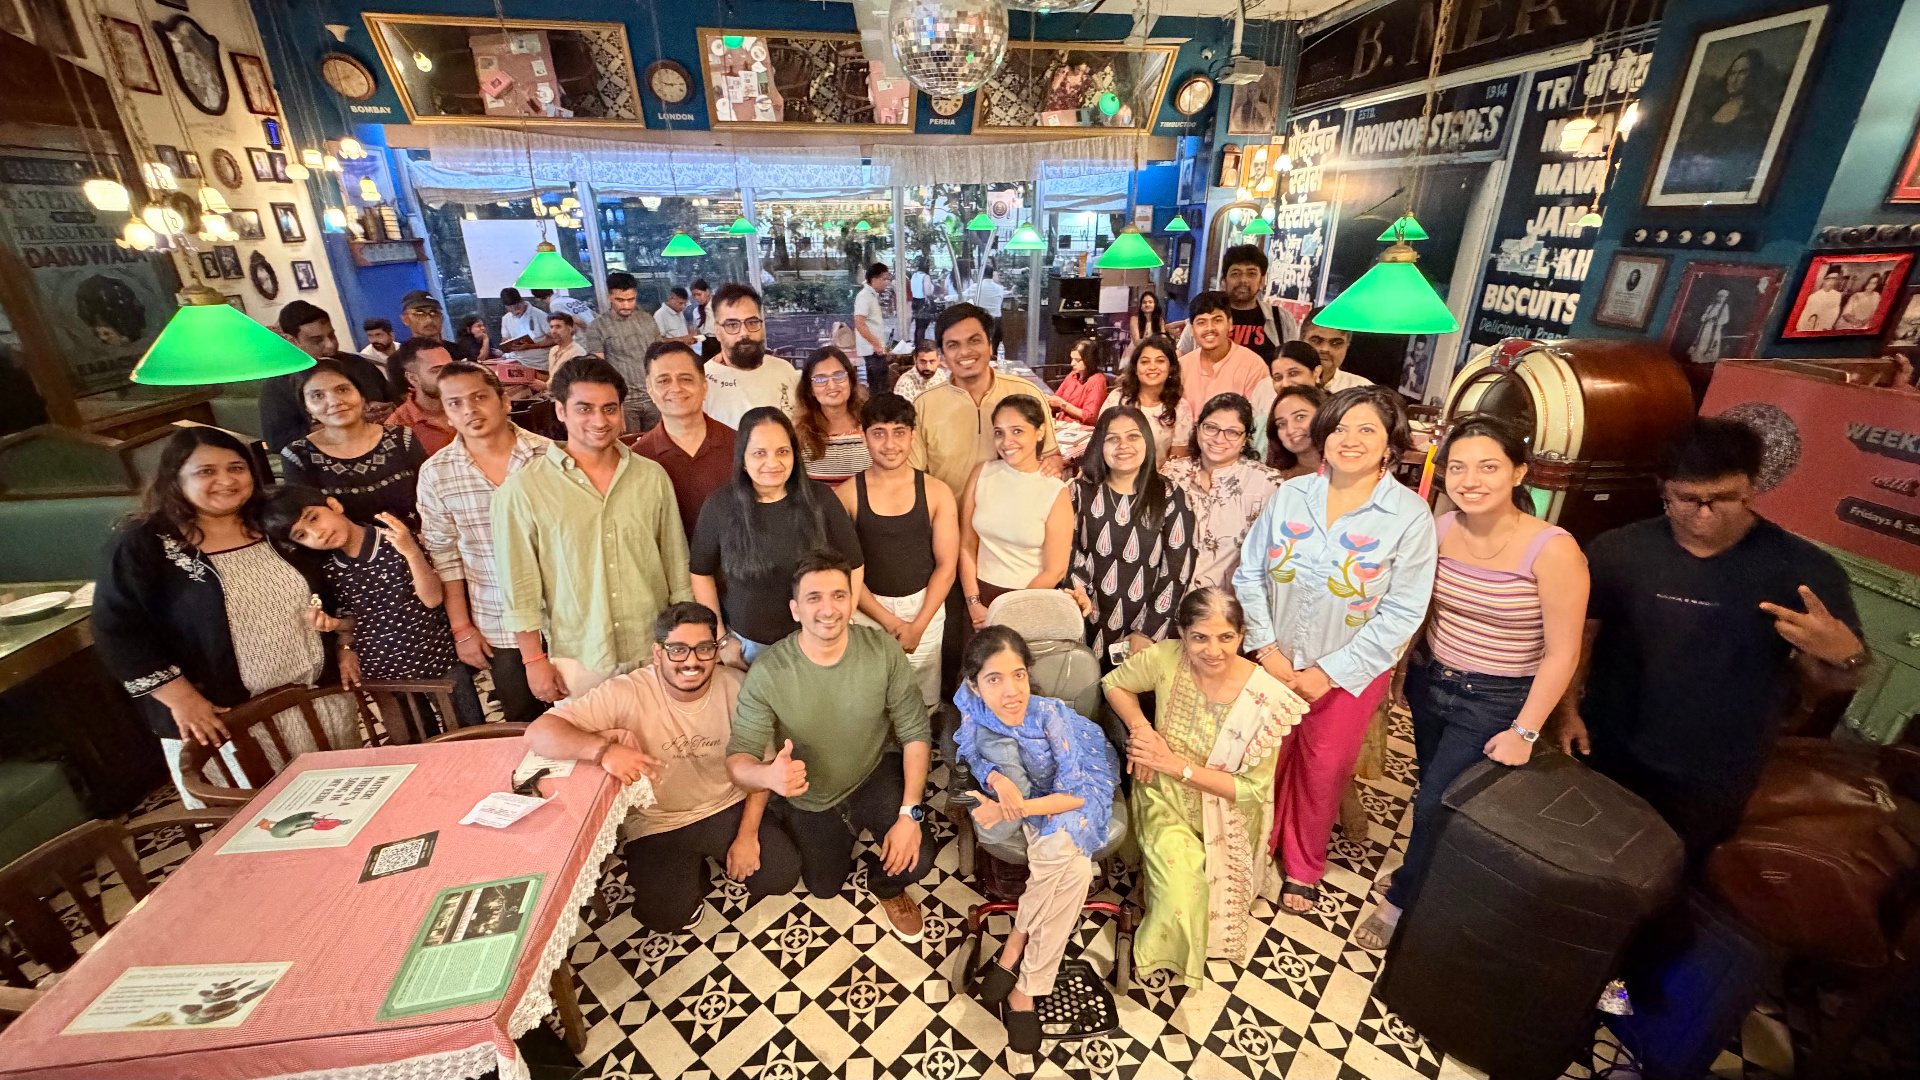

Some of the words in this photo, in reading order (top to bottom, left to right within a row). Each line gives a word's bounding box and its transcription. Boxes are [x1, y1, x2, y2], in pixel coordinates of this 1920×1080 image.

[1485, 83, 1509, 100] 1914
[350, 105, 392, 114] BOMBAY
[657, 112, 695, 121] LONDON
[929, 118, 956, 126] PERSIA
[1427, 105, 1504, 150] STORES
[1535, 160, 1609, 195] MAVA
[1526, 205, 1590, 240] JAM
[1482, 283, 1581, 325] BISCUITS
[1228, 324, 1265, 346] VI'S
[1478, 317, 1532, 339] Deliciously
[1849, 506, 1892, 526] Fridays
